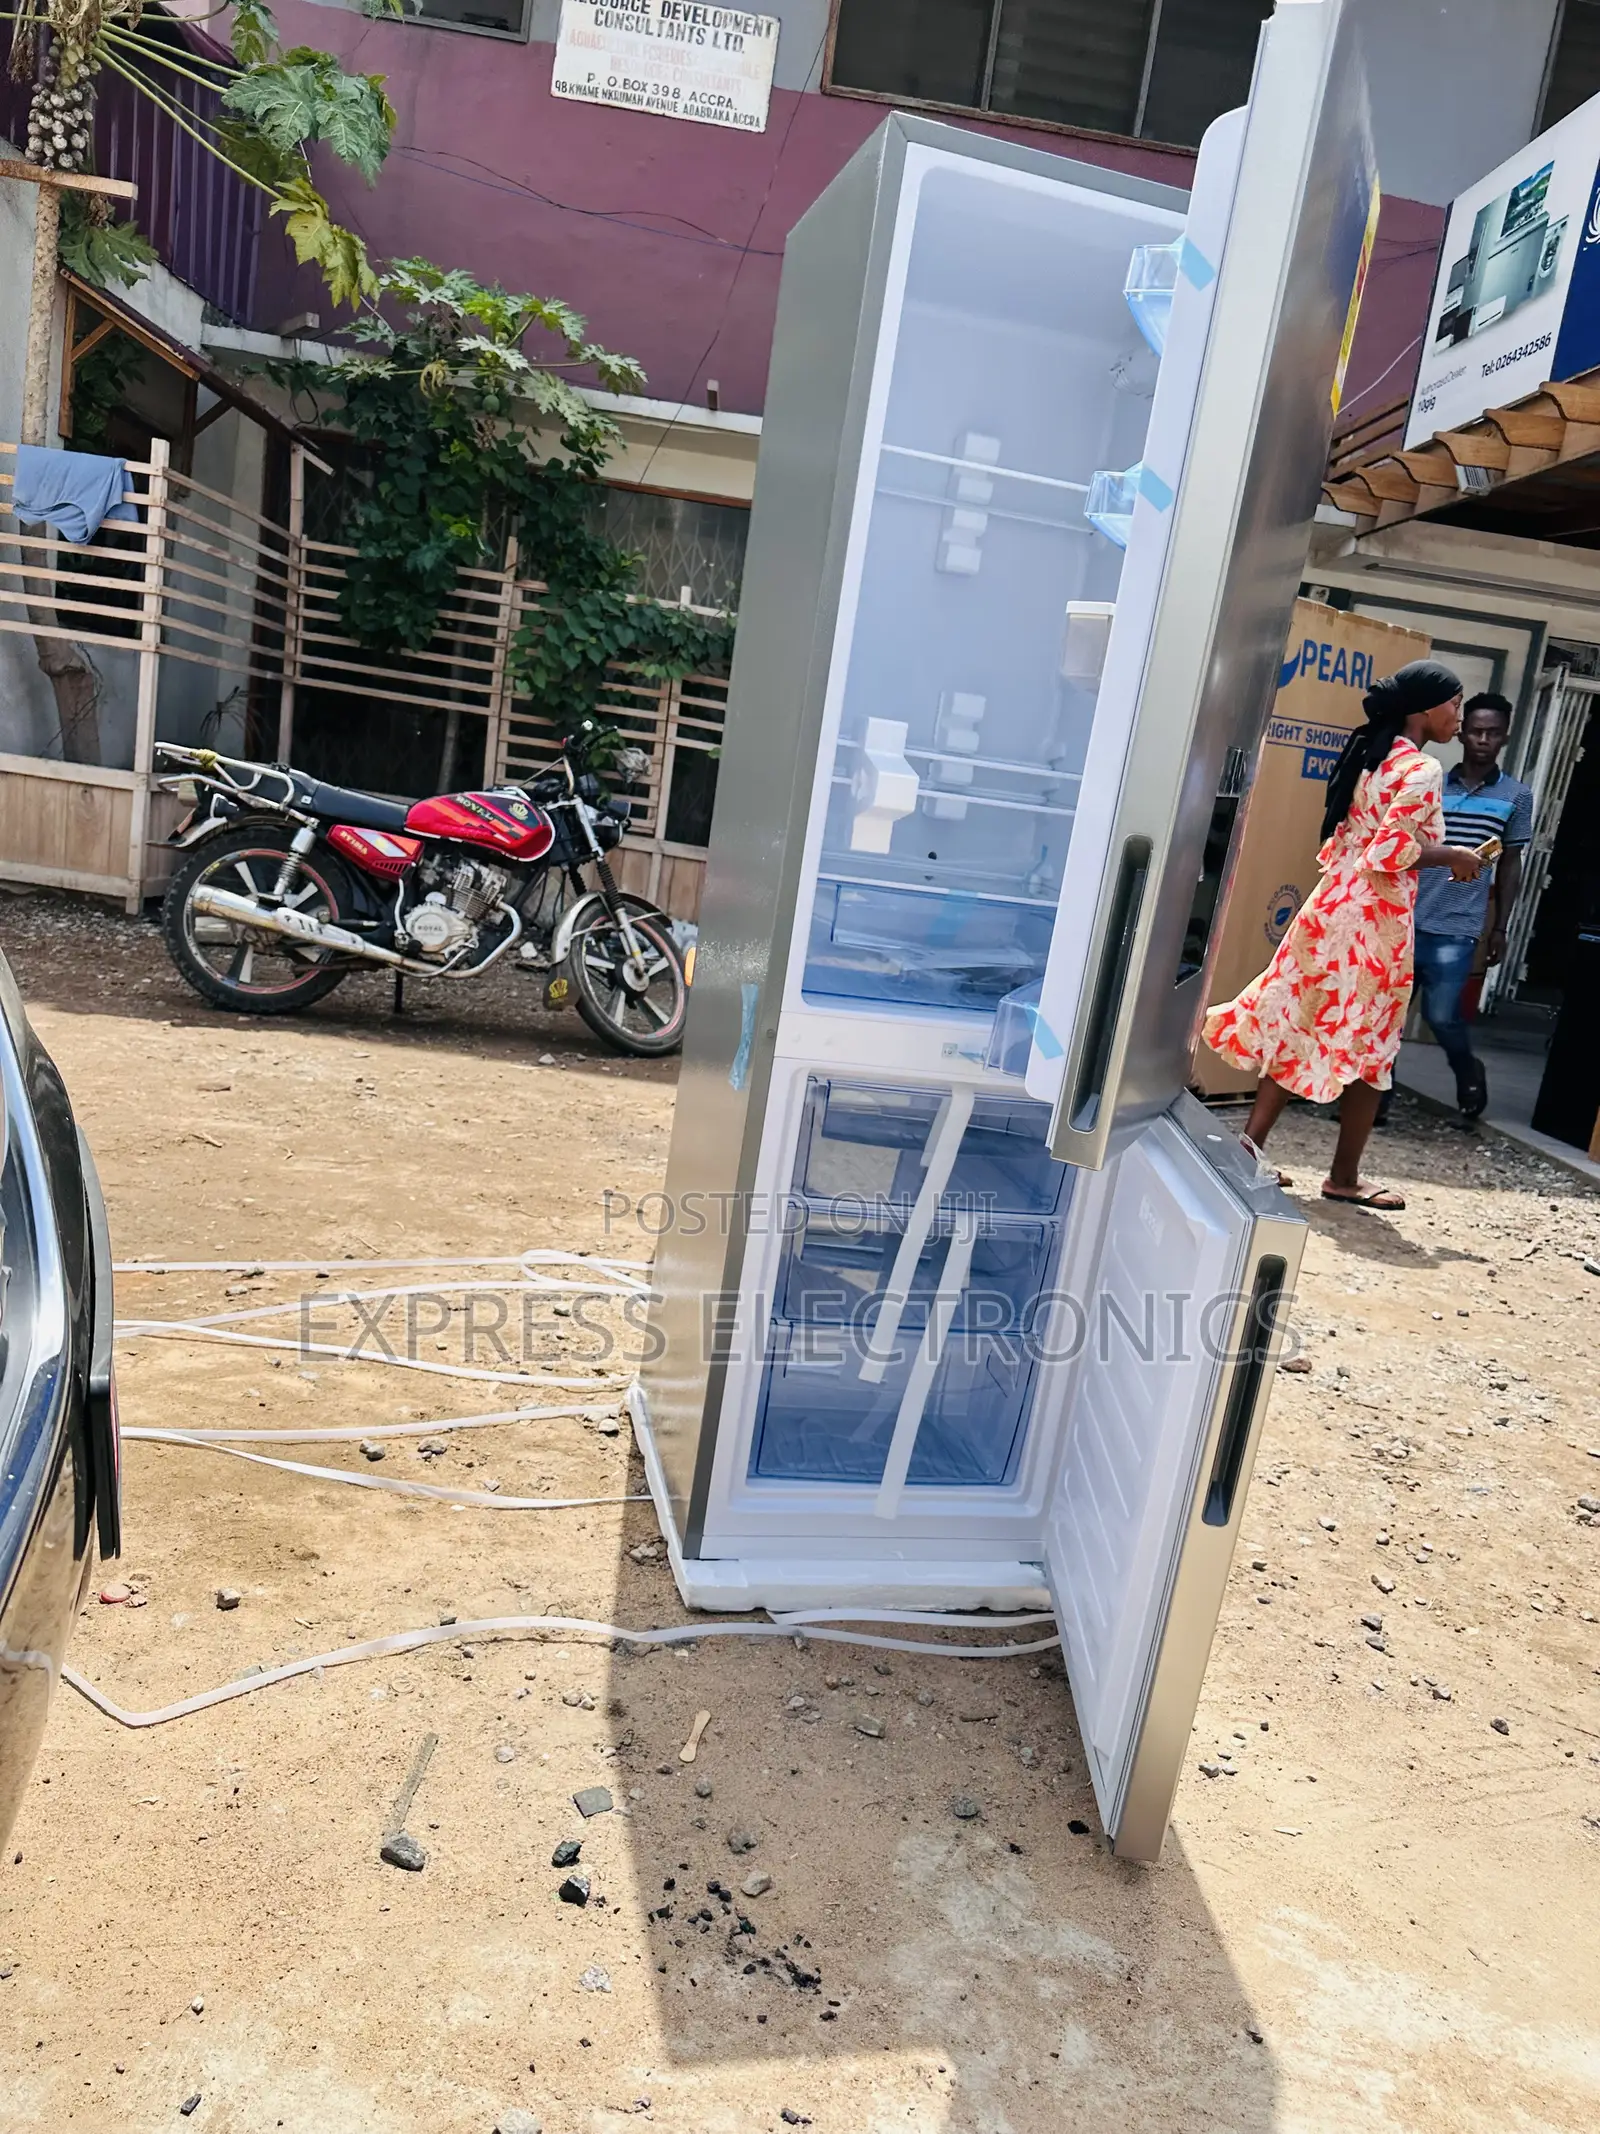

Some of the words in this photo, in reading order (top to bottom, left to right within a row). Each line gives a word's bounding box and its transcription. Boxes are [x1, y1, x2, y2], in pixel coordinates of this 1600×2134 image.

[594, 8, 706, 46] CONSULTANTS
[712, 30, 745, 54] LTD.
[661, 1, 774, 38] DEVELOPMENT
[602, 88, 643, 106] NKRUMAH
[646, 96, 678, 112] AVENUE
[683, 104, 730, 122] ADABRAKA
[733, 112, 760, 128] ACCRA
[689, 91, 738, 110] ACCRA.
[1481, 360, 1495, 378] Tel:
[1495, 332, 1552, 371] 0264342586
[1300, 639, 1374, 690] PEARL
[1305, 728, 1352, 747] SHOWC
[456, 795, 494, 820] ROYAL
